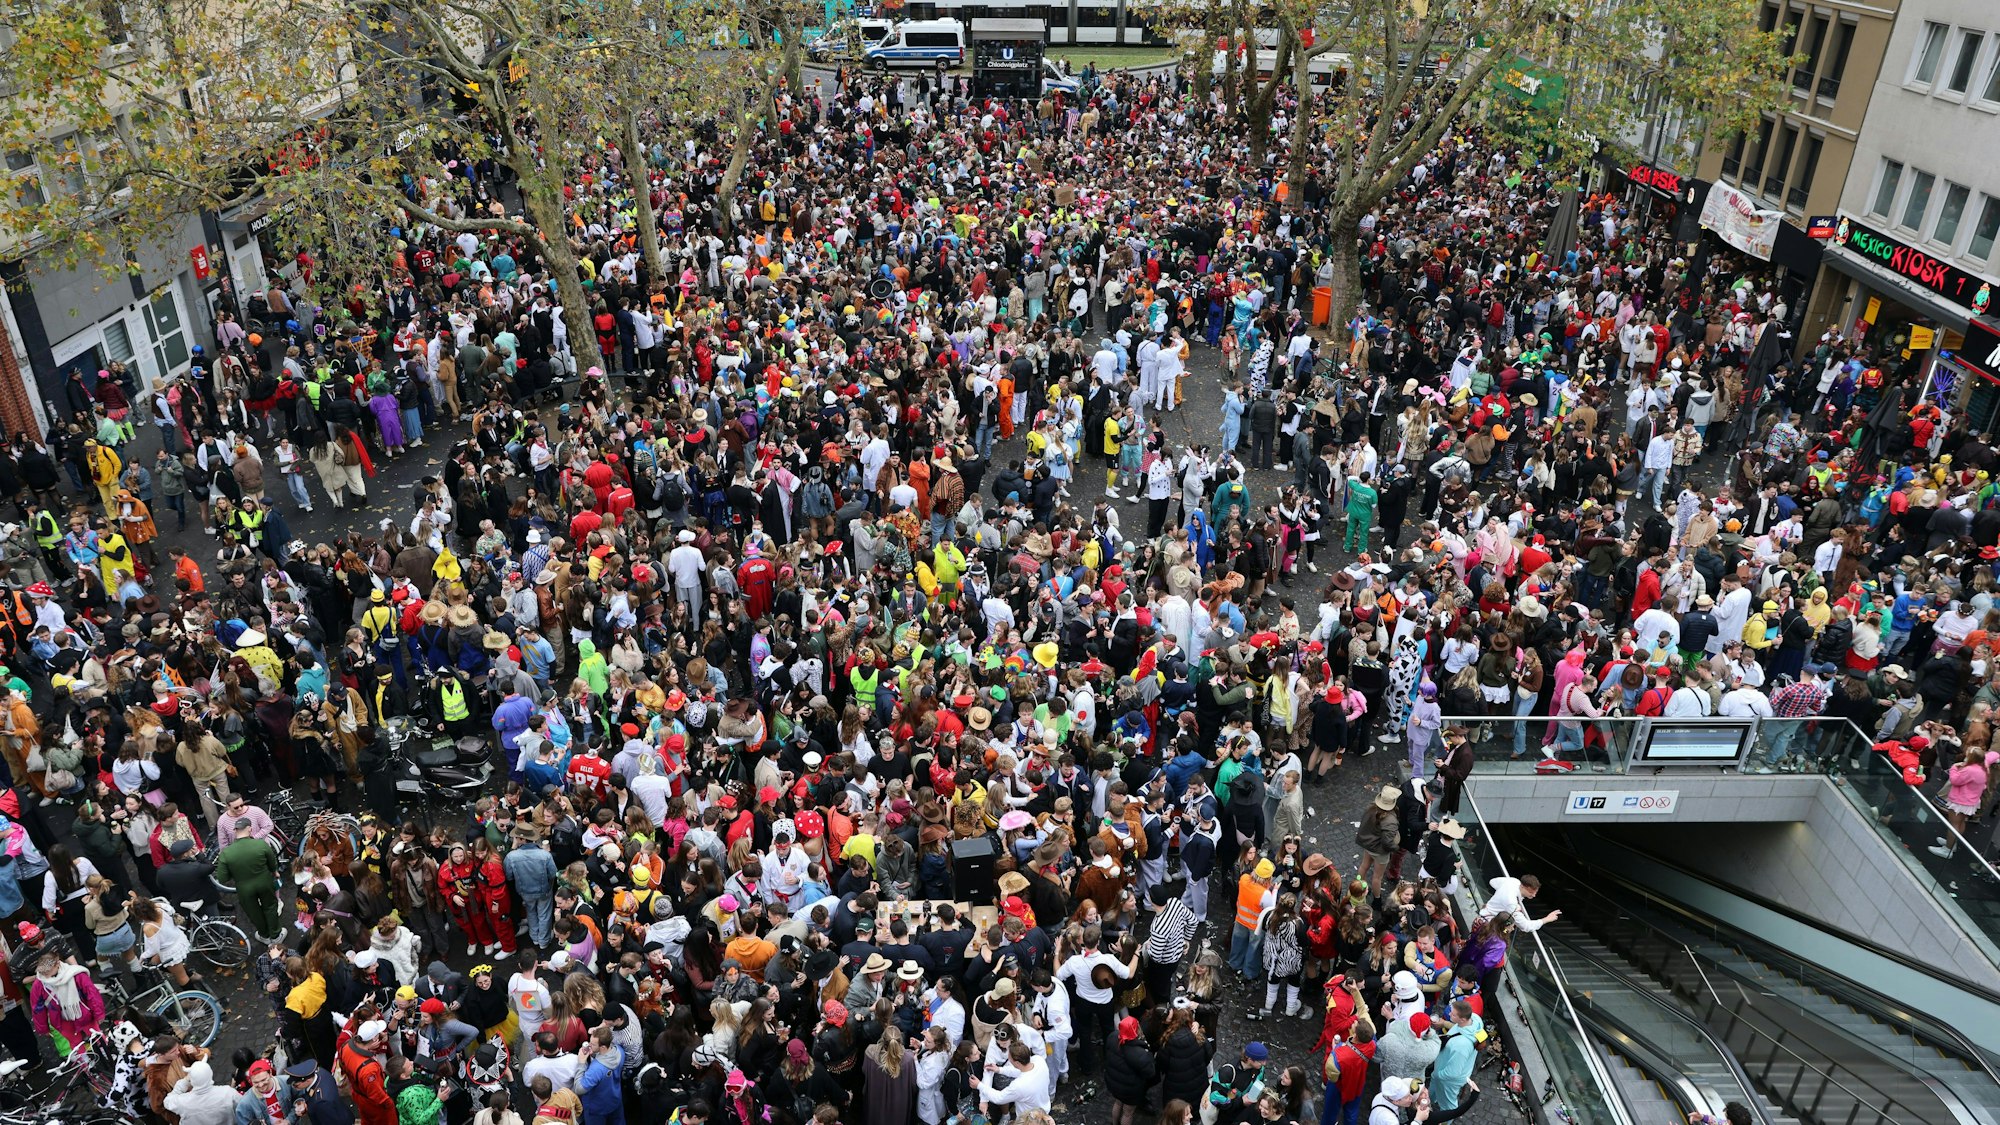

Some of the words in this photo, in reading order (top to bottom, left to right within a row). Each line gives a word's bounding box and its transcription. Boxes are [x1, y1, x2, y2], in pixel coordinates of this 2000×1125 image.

[1003, 48, 1013, 60] U
[987, 61, 1028, 69] Chlodwigplatz
[1631, 165, 1680, 193] KIOSK
[1816, 218, 1831, 228] sky
[1812, 229, 1829, 237] sport
[422, 257, 431, 267] 12
[1851, 229, 1893, 260] MEXICO
[1891, 246, 1950, 291] KIOSK
[580, 765, 594, 774] KELCE
[1592, 798, 1605, 807] 17
